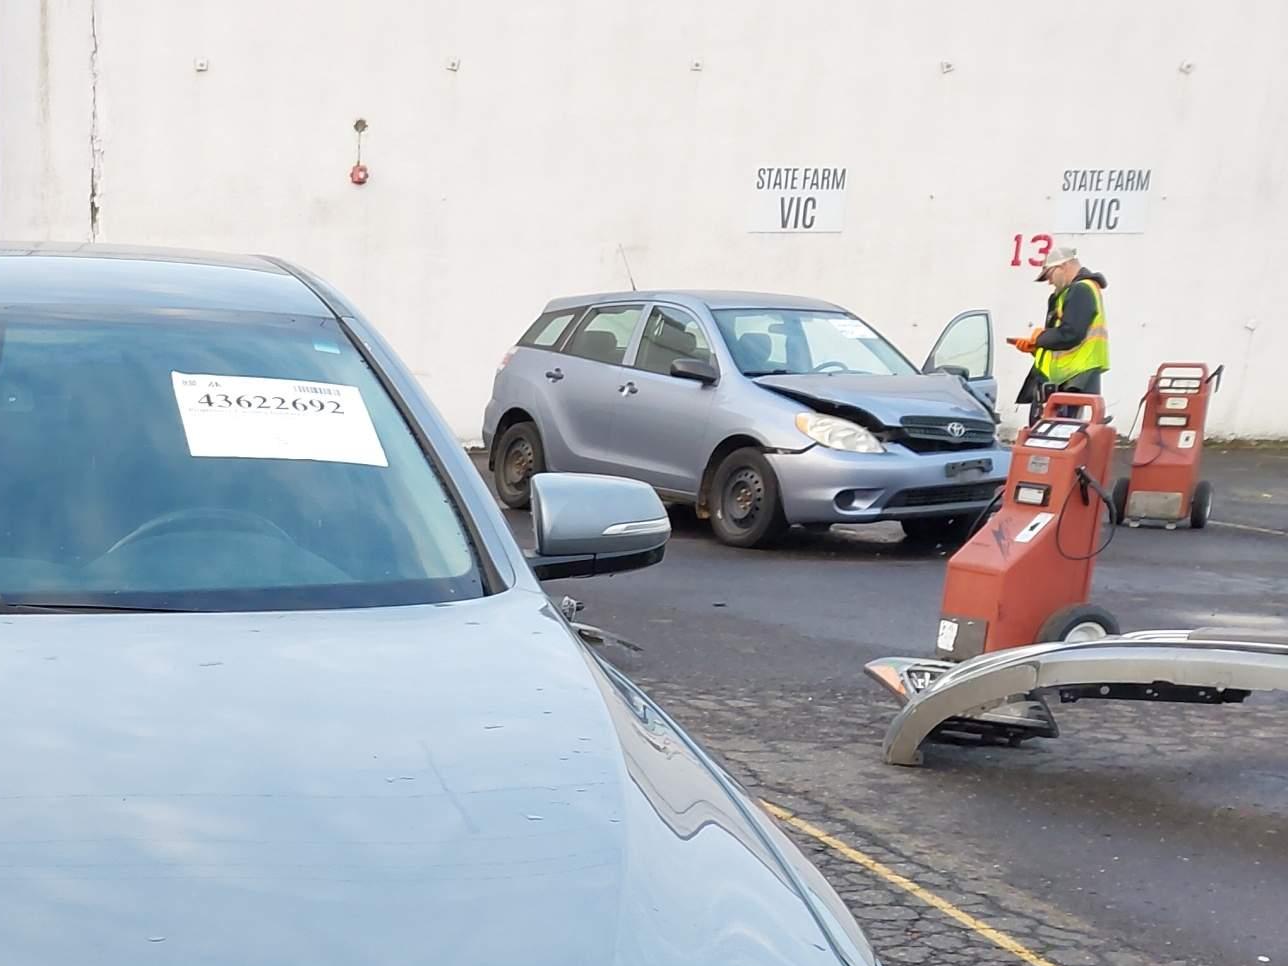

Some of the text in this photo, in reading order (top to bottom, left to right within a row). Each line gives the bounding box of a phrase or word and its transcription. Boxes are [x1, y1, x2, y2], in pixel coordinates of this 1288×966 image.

[756, 167, 847, 190] STATE FARM
[1062, 169, 1151, 192] STATE FARM
[780, 196, 817, 229] VIC
[1085, 198, 1120, 230] VIC
[1010, 233, 1054, 267] 13
[198, 393, 345, 415] 43622692
